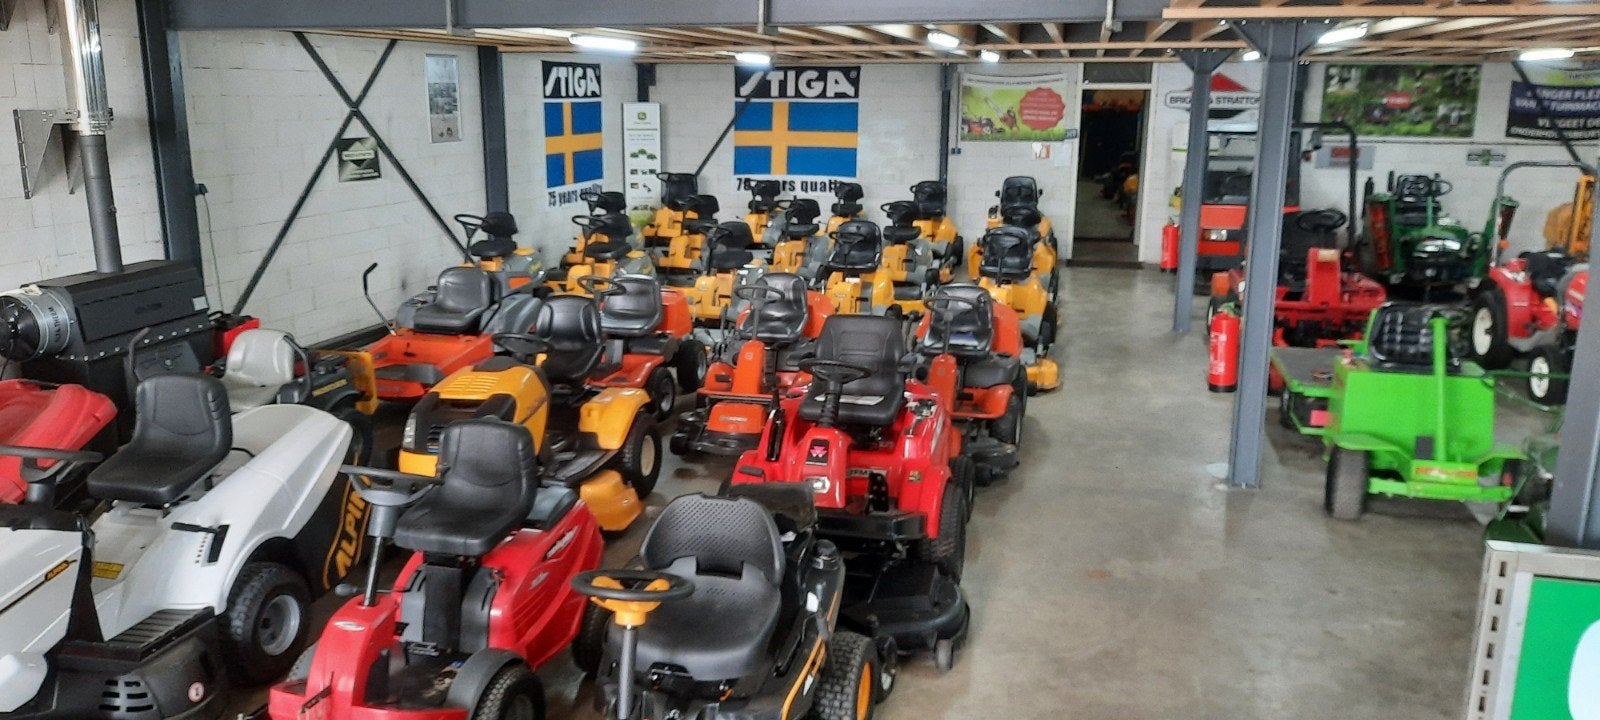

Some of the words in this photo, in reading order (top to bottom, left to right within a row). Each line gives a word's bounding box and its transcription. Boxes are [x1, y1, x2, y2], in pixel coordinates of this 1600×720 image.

[544, 66, 601, 97] STIGA
[739, 69, 857, 97] STIGA
[1169, 96, 1192, 105] BRIG
[800, 180, 840, 193] quali
